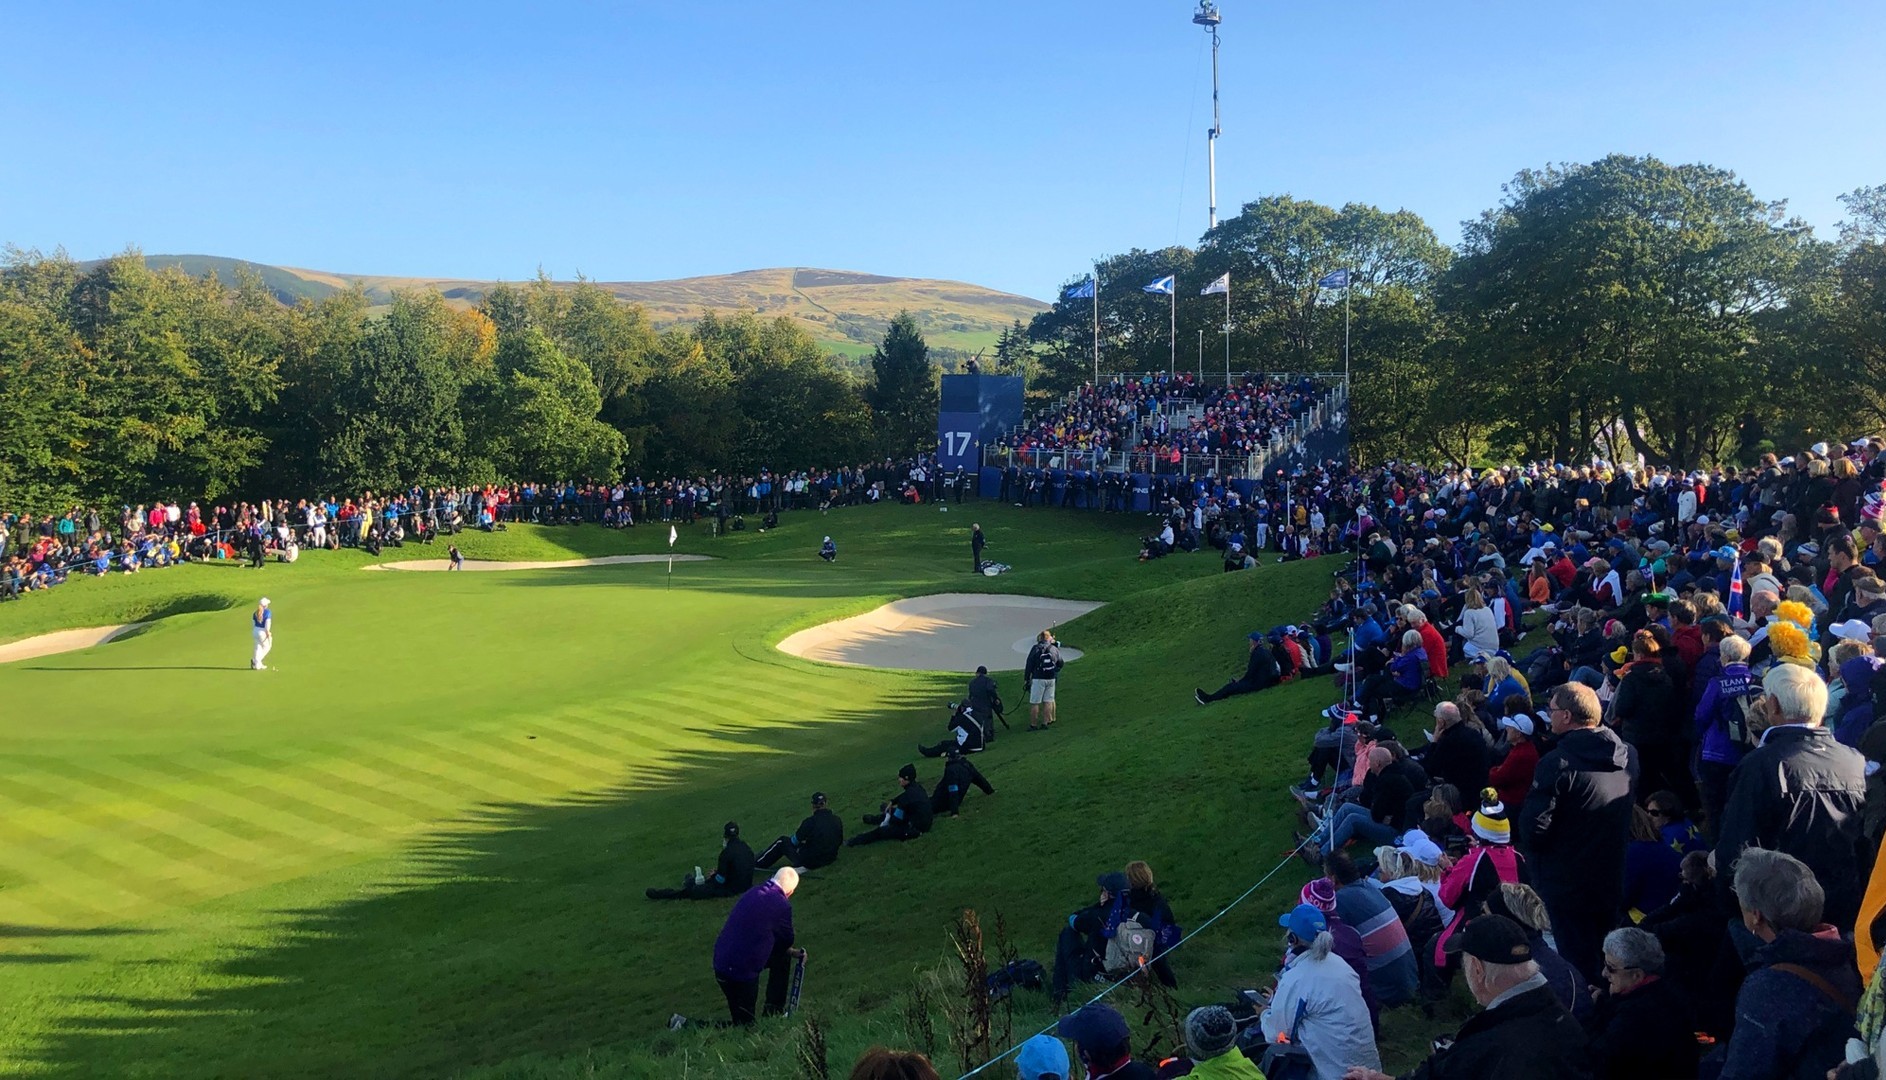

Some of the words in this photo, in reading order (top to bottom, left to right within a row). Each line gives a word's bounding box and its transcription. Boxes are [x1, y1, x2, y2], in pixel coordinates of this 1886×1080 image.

[944, 431, 972, 456] 17
[1720, 678, 1745, 688] TEAM
[1722, 685, 1746, 694] EUROPE
